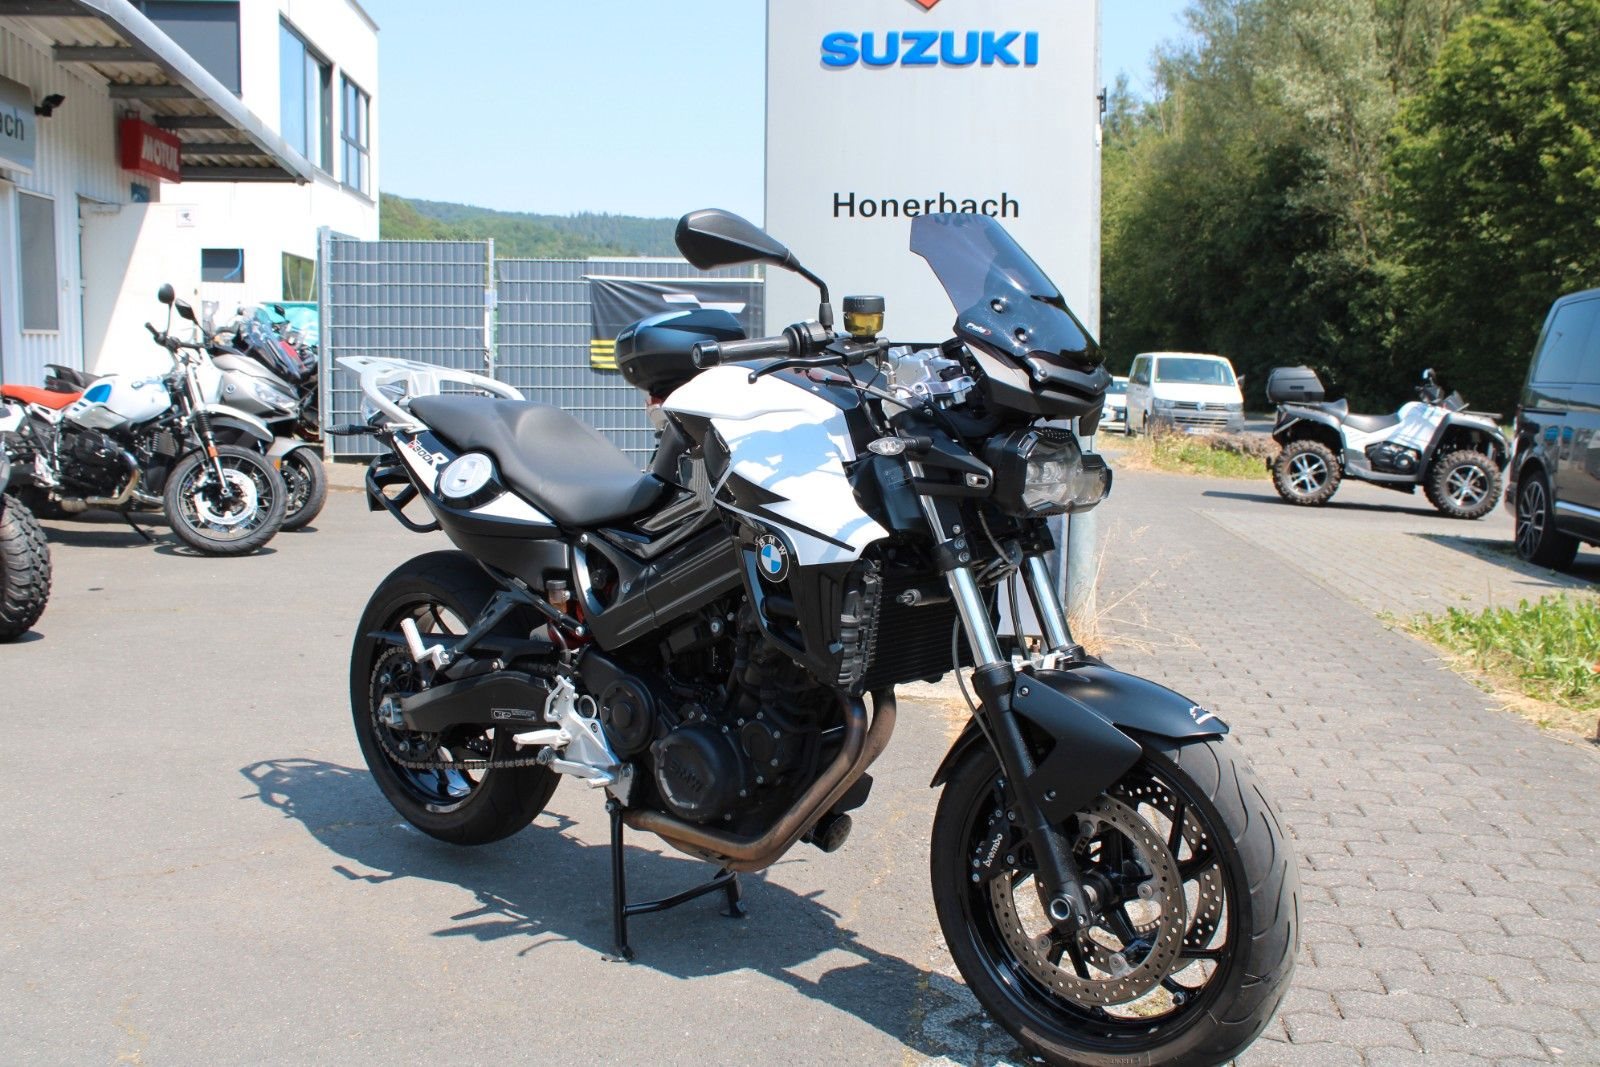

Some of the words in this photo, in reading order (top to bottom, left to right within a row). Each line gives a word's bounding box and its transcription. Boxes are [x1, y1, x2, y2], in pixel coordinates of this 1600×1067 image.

[821, 31, 1039, 67] SUZUKI
[141, 133, 179, 173] MOTUL
[833, 192, 1019, 218] Honerbach
[758, 536, 787, 556] BMW
[983, 833, 1003, 868] brembo
